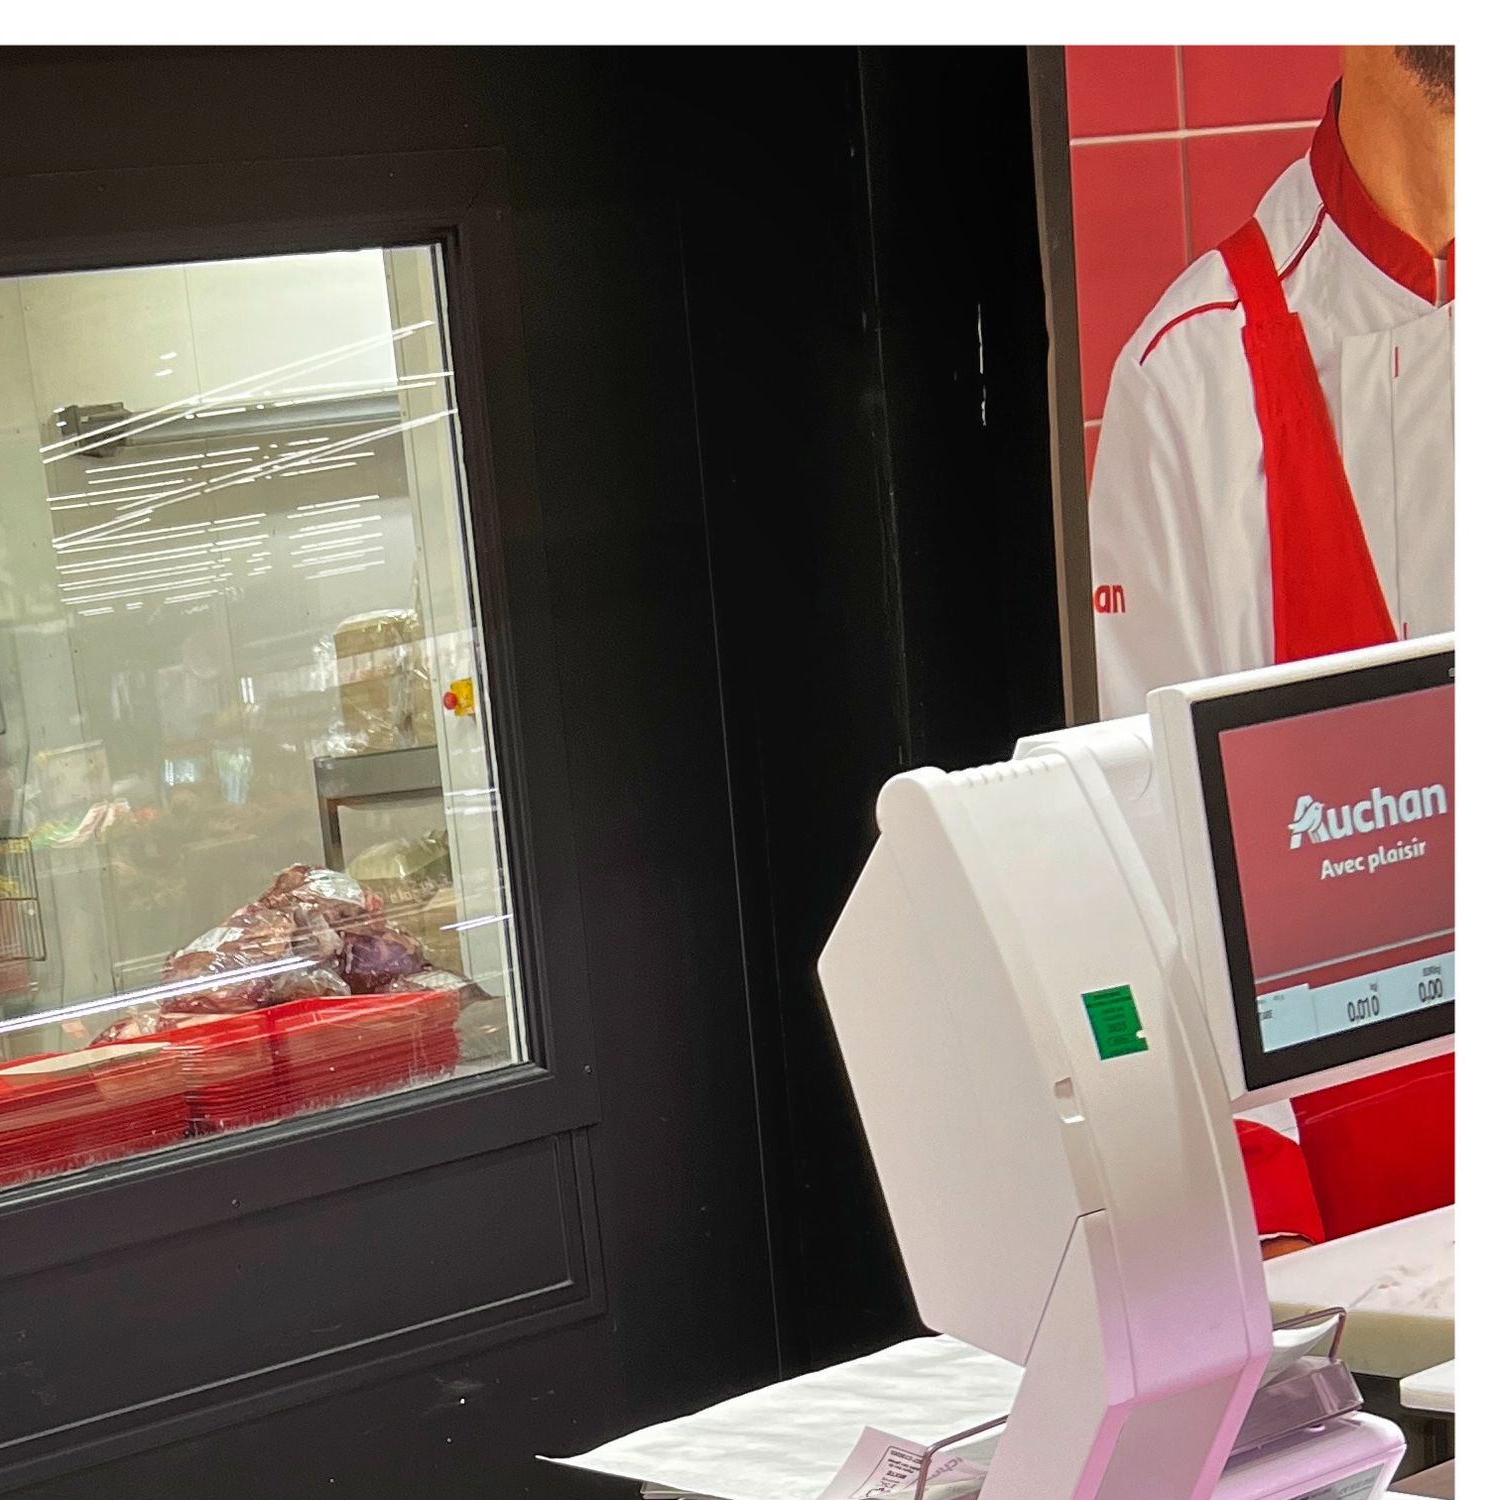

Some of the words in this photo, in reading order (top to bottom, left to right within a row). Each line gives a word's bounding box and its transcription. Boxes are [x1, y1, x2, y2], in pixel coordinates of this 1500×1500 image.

[1288, 783, 1449, 850] Auchan
[1320, 855, 1365, 880] Avec
[1367, 838, 1427, 874] plaisir
